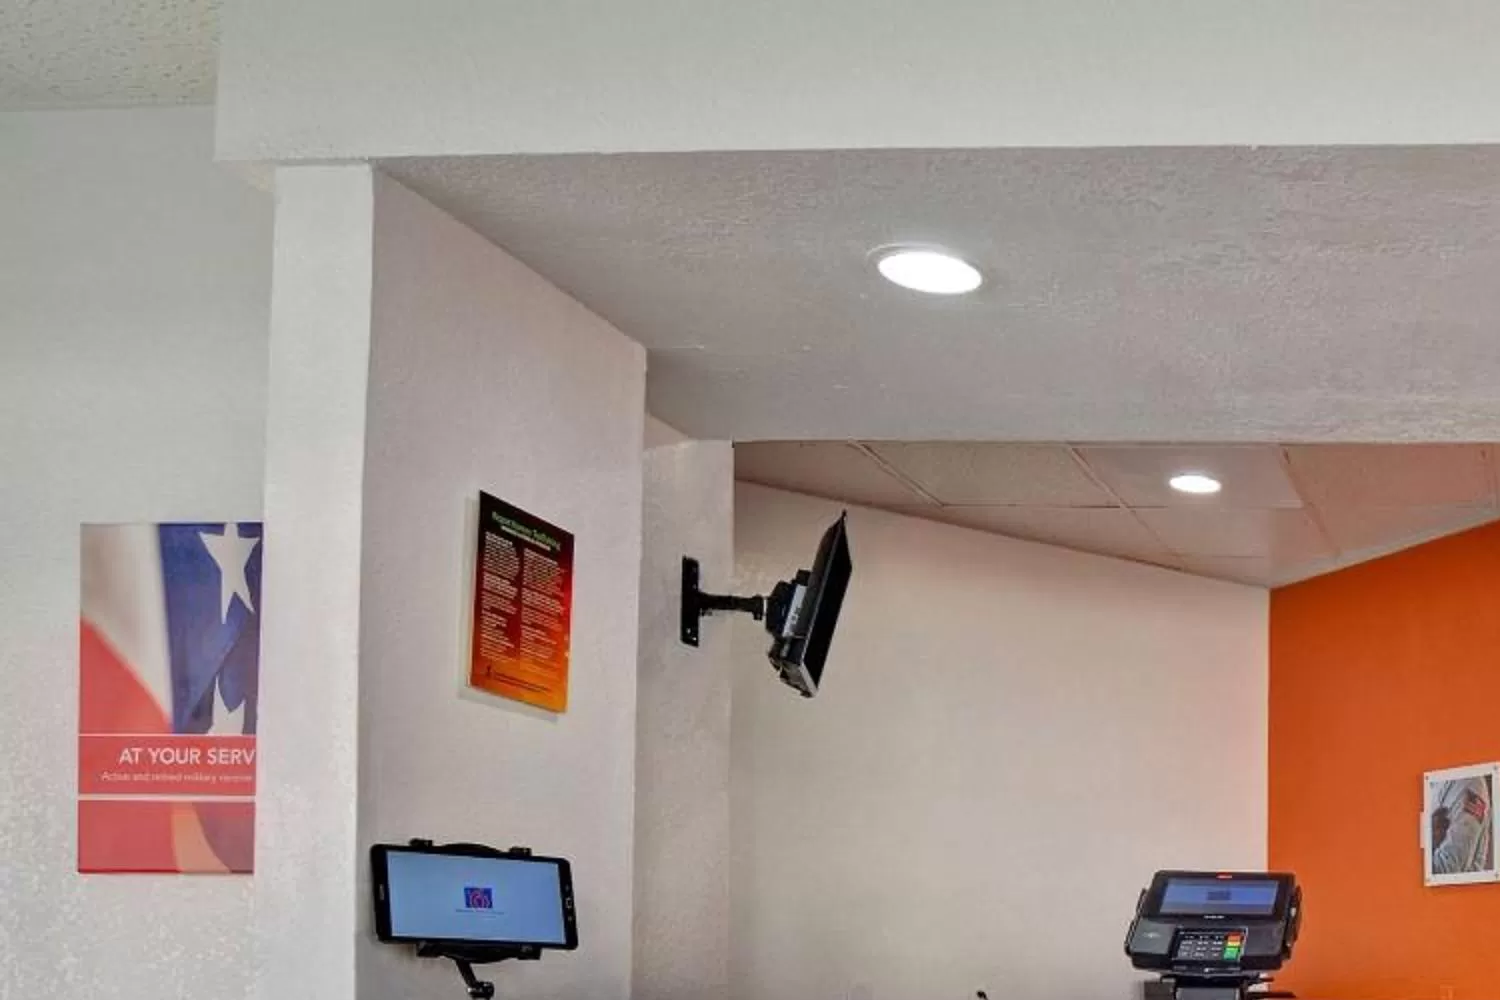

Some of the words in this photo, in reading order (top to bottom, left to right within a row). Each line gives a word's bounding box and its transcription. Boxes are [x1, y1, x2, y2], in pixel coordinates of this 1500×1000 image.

[119, 747, 144, 765] AT
[147, 747, 201, 765] YOUR
[206, 747, 256, 765] SERV
